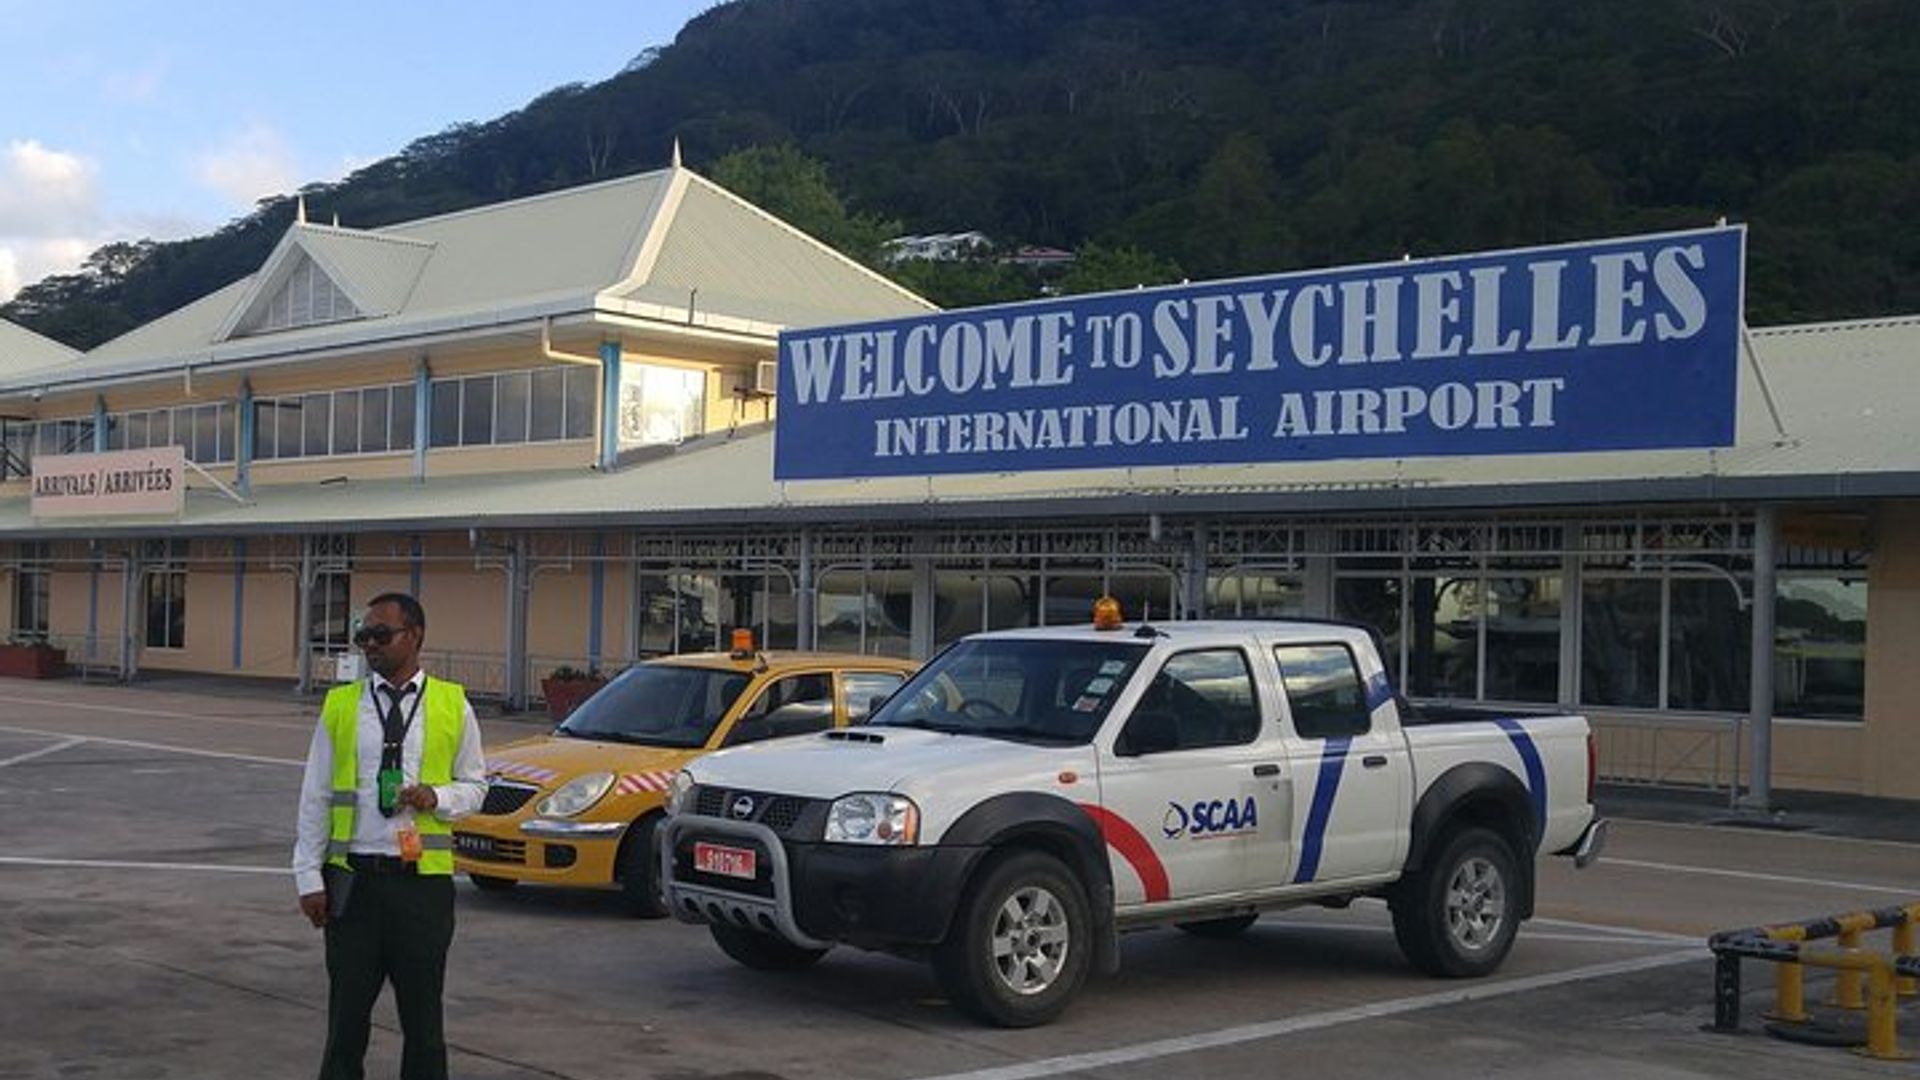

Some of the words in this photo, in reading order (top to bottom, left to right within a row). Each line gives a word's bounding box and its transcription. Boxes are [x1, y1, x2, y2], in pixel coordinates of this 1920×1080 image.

[788, 310, 1075, 404] WELCOME
[1085, 311, 1143, 369] TO
[1153, 244, 1707, 379] SEYCHELLES
[874, 396, 1250, 457] INTERNATIONAL
[1273, 377, 1565, 438] AIRPORT
[1189, 796, 1258, 834] SCAA
